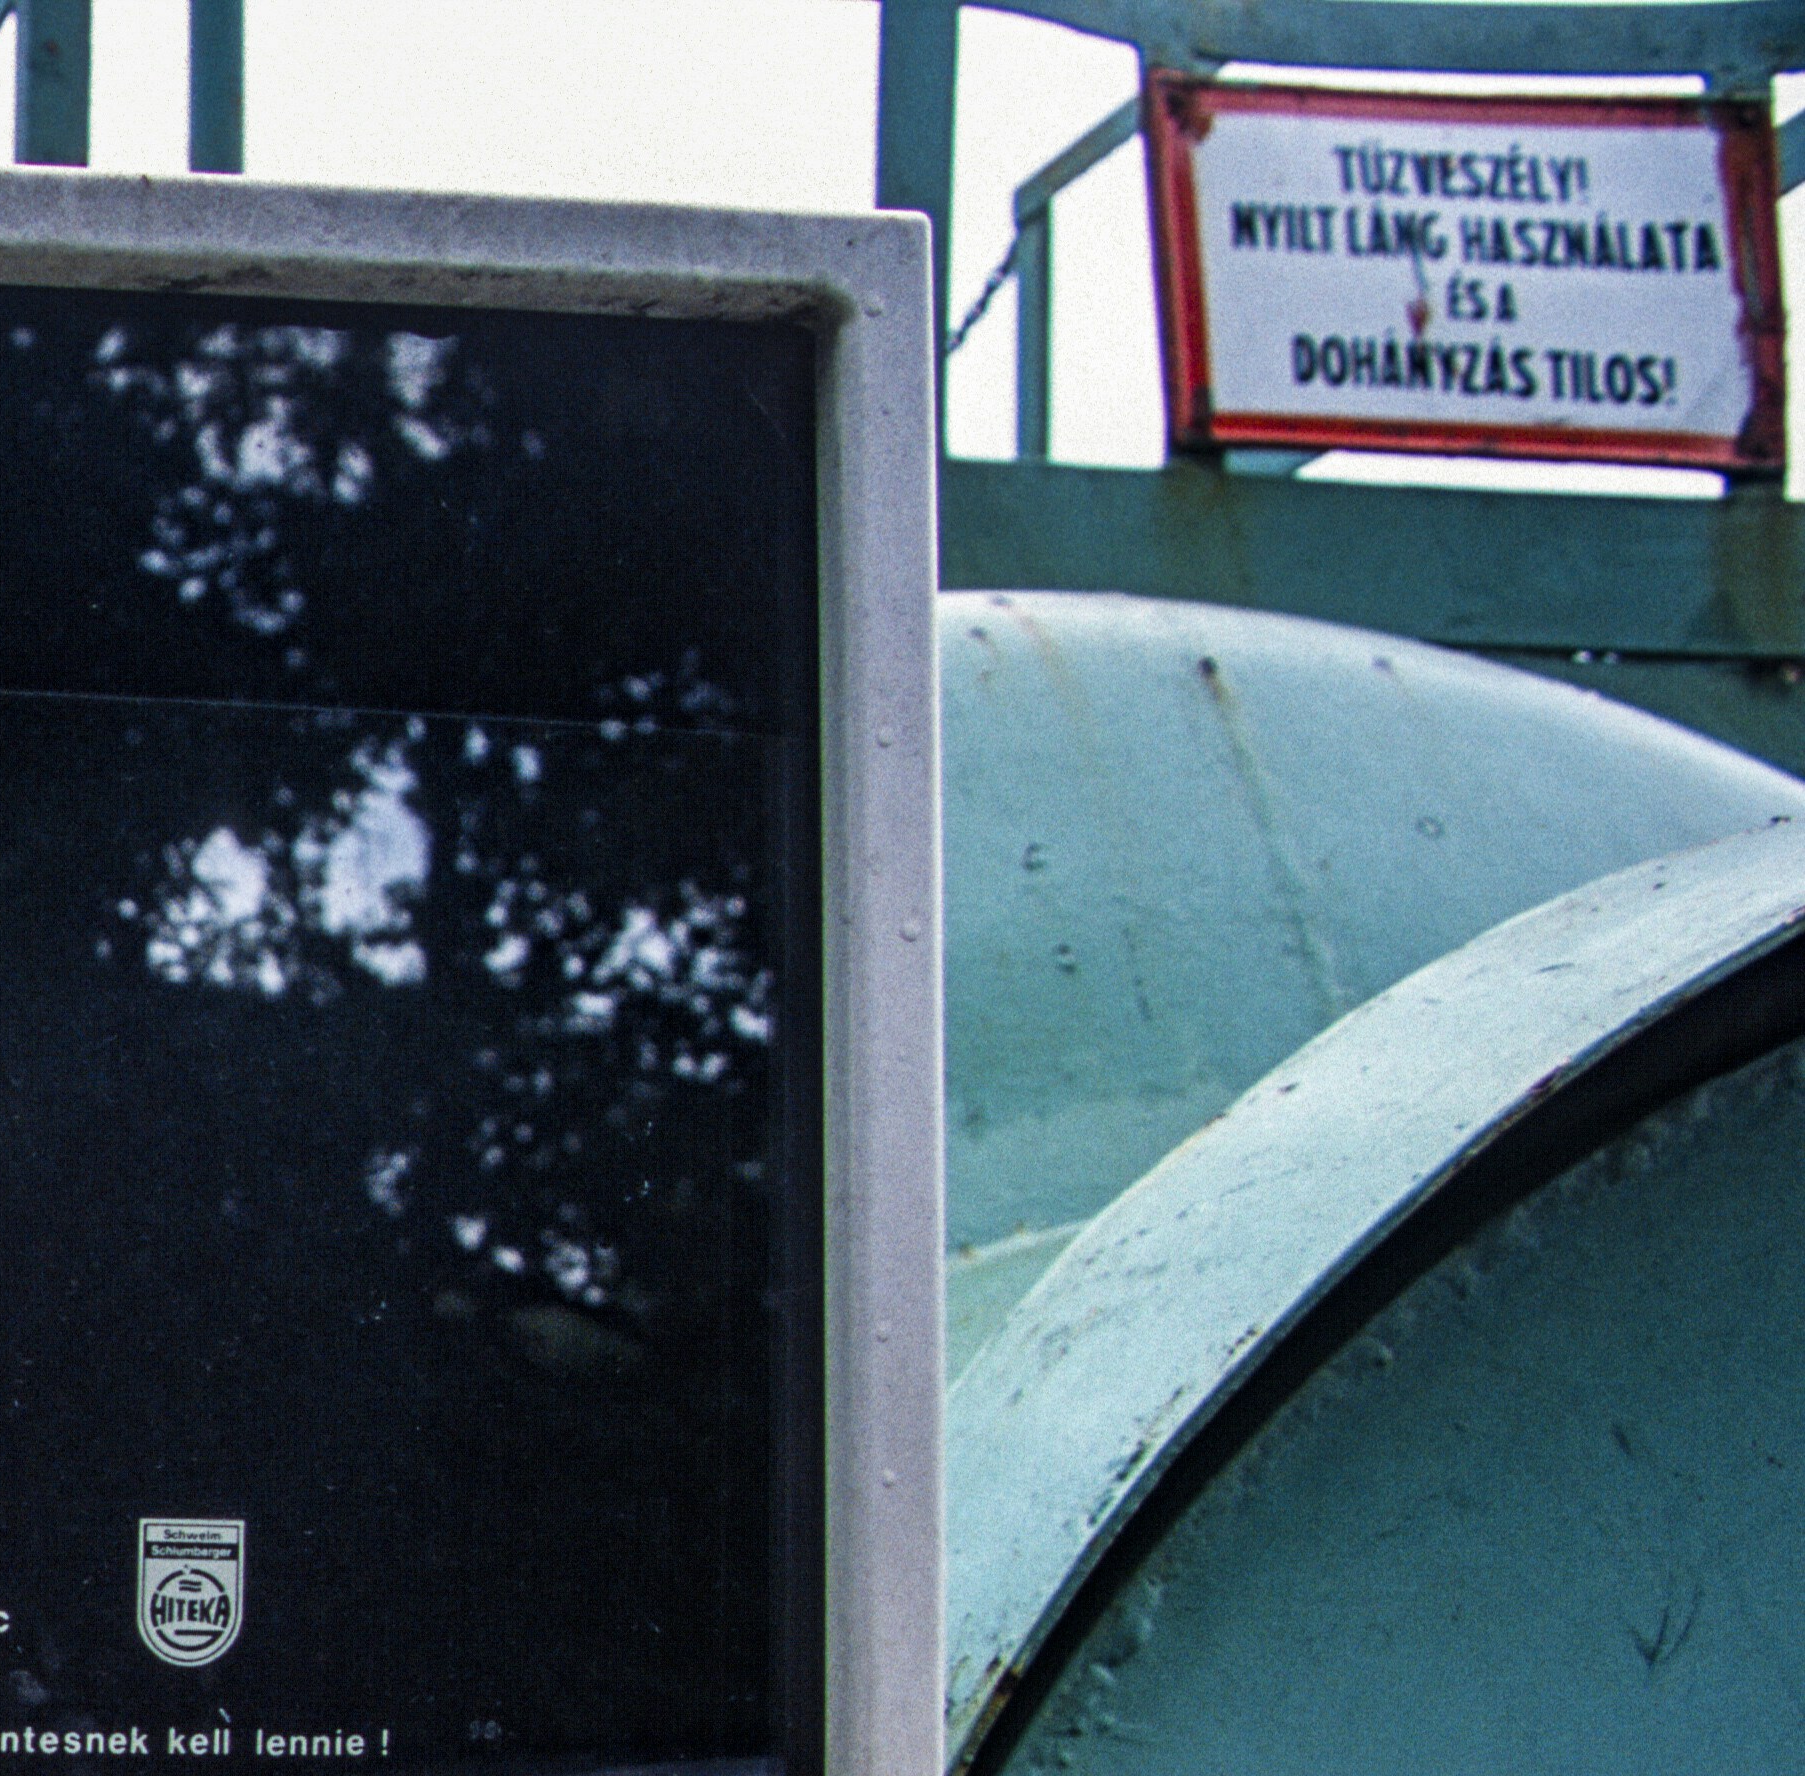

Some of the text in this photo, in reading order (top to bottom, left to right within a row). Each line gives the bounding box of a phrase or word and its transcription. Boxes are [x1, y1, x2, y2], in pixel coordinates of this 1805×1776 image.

[1347, 201, 1448, 261] LÁNG
[1460, 209, 1722, 273] HASZNÁLATA
[1446, 271, 1517, 323] ÉS A
[1293, 327, 1678, 405] DOHÁNYZÁS TILOS!
[150, 1592, 231, 1628] HITEKA
[168, 1727, 230, 1755] kell
